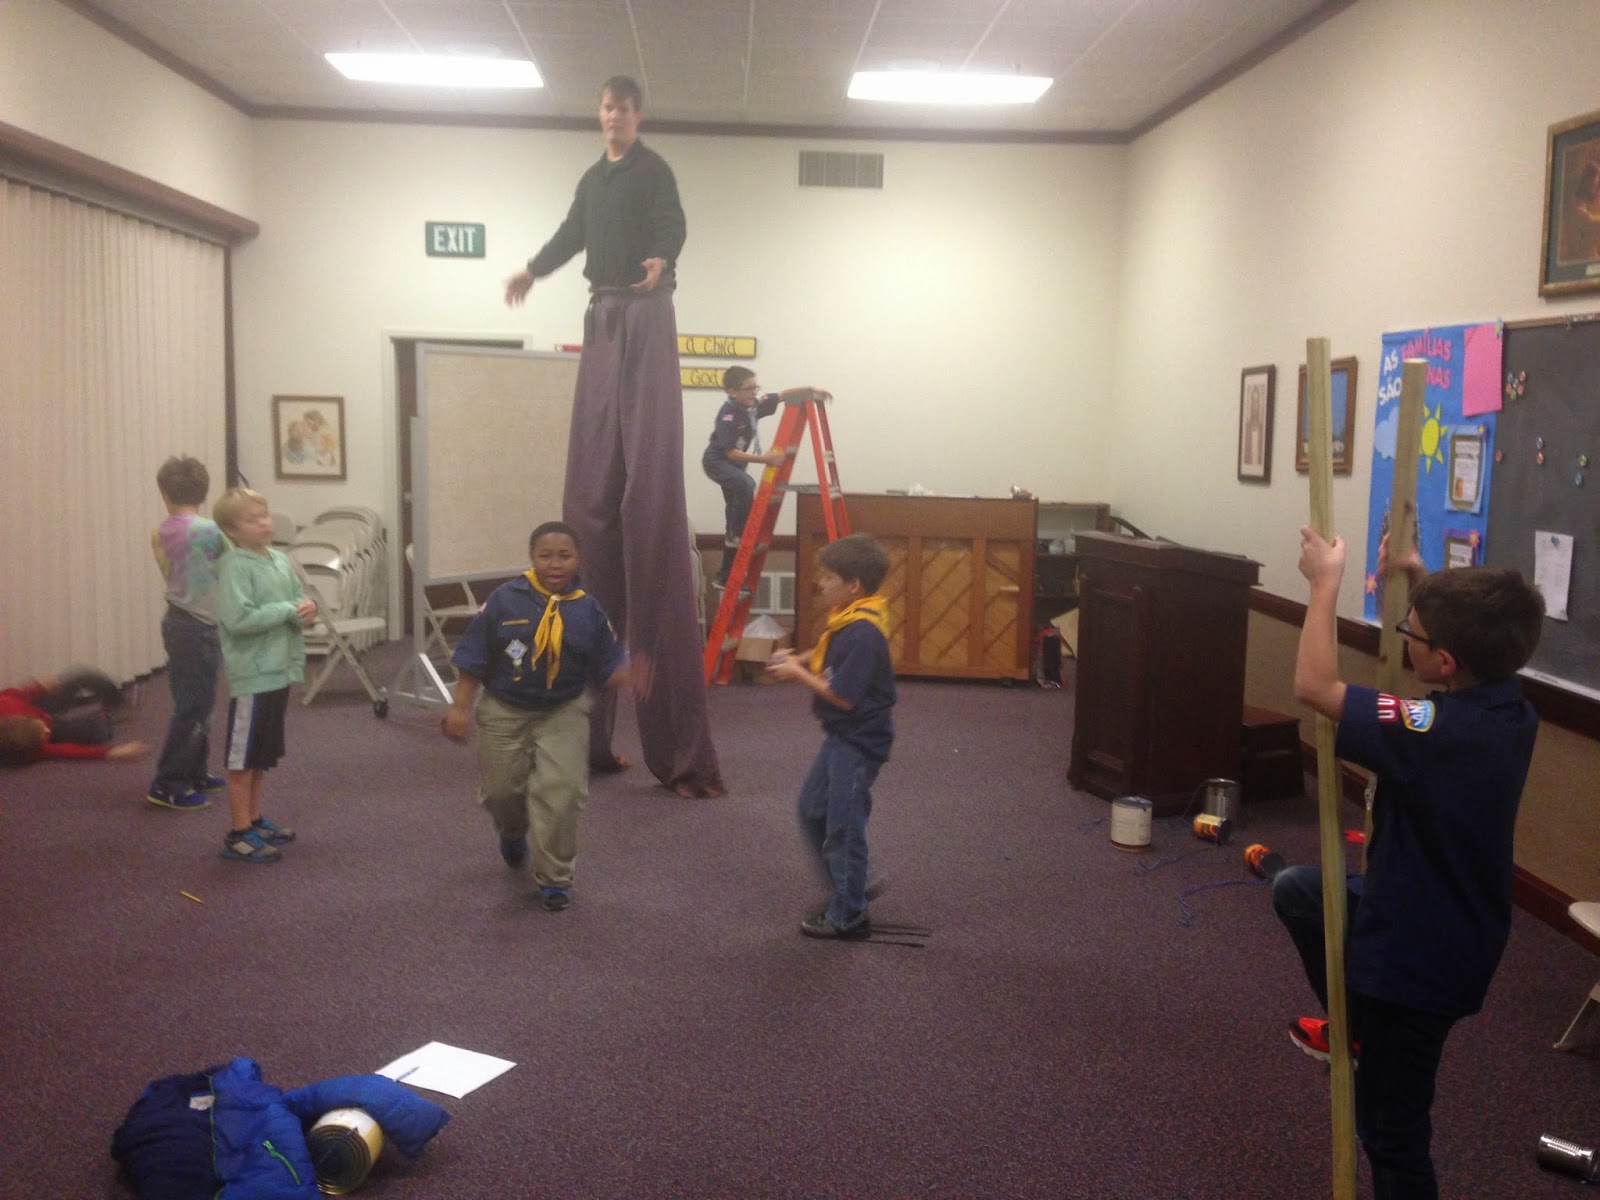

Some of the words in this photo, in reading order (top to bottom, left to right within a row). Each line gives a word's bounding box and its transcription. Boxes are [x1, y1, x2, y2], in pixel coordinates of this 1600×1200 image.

[433, 224, 476, 253] EXIT
[704, 335, 737, 356] Child
[1383, 349, 1399, 376] AS
[691, 369, 720, 387] God
[1426, 365, 1451, 391] NAS
